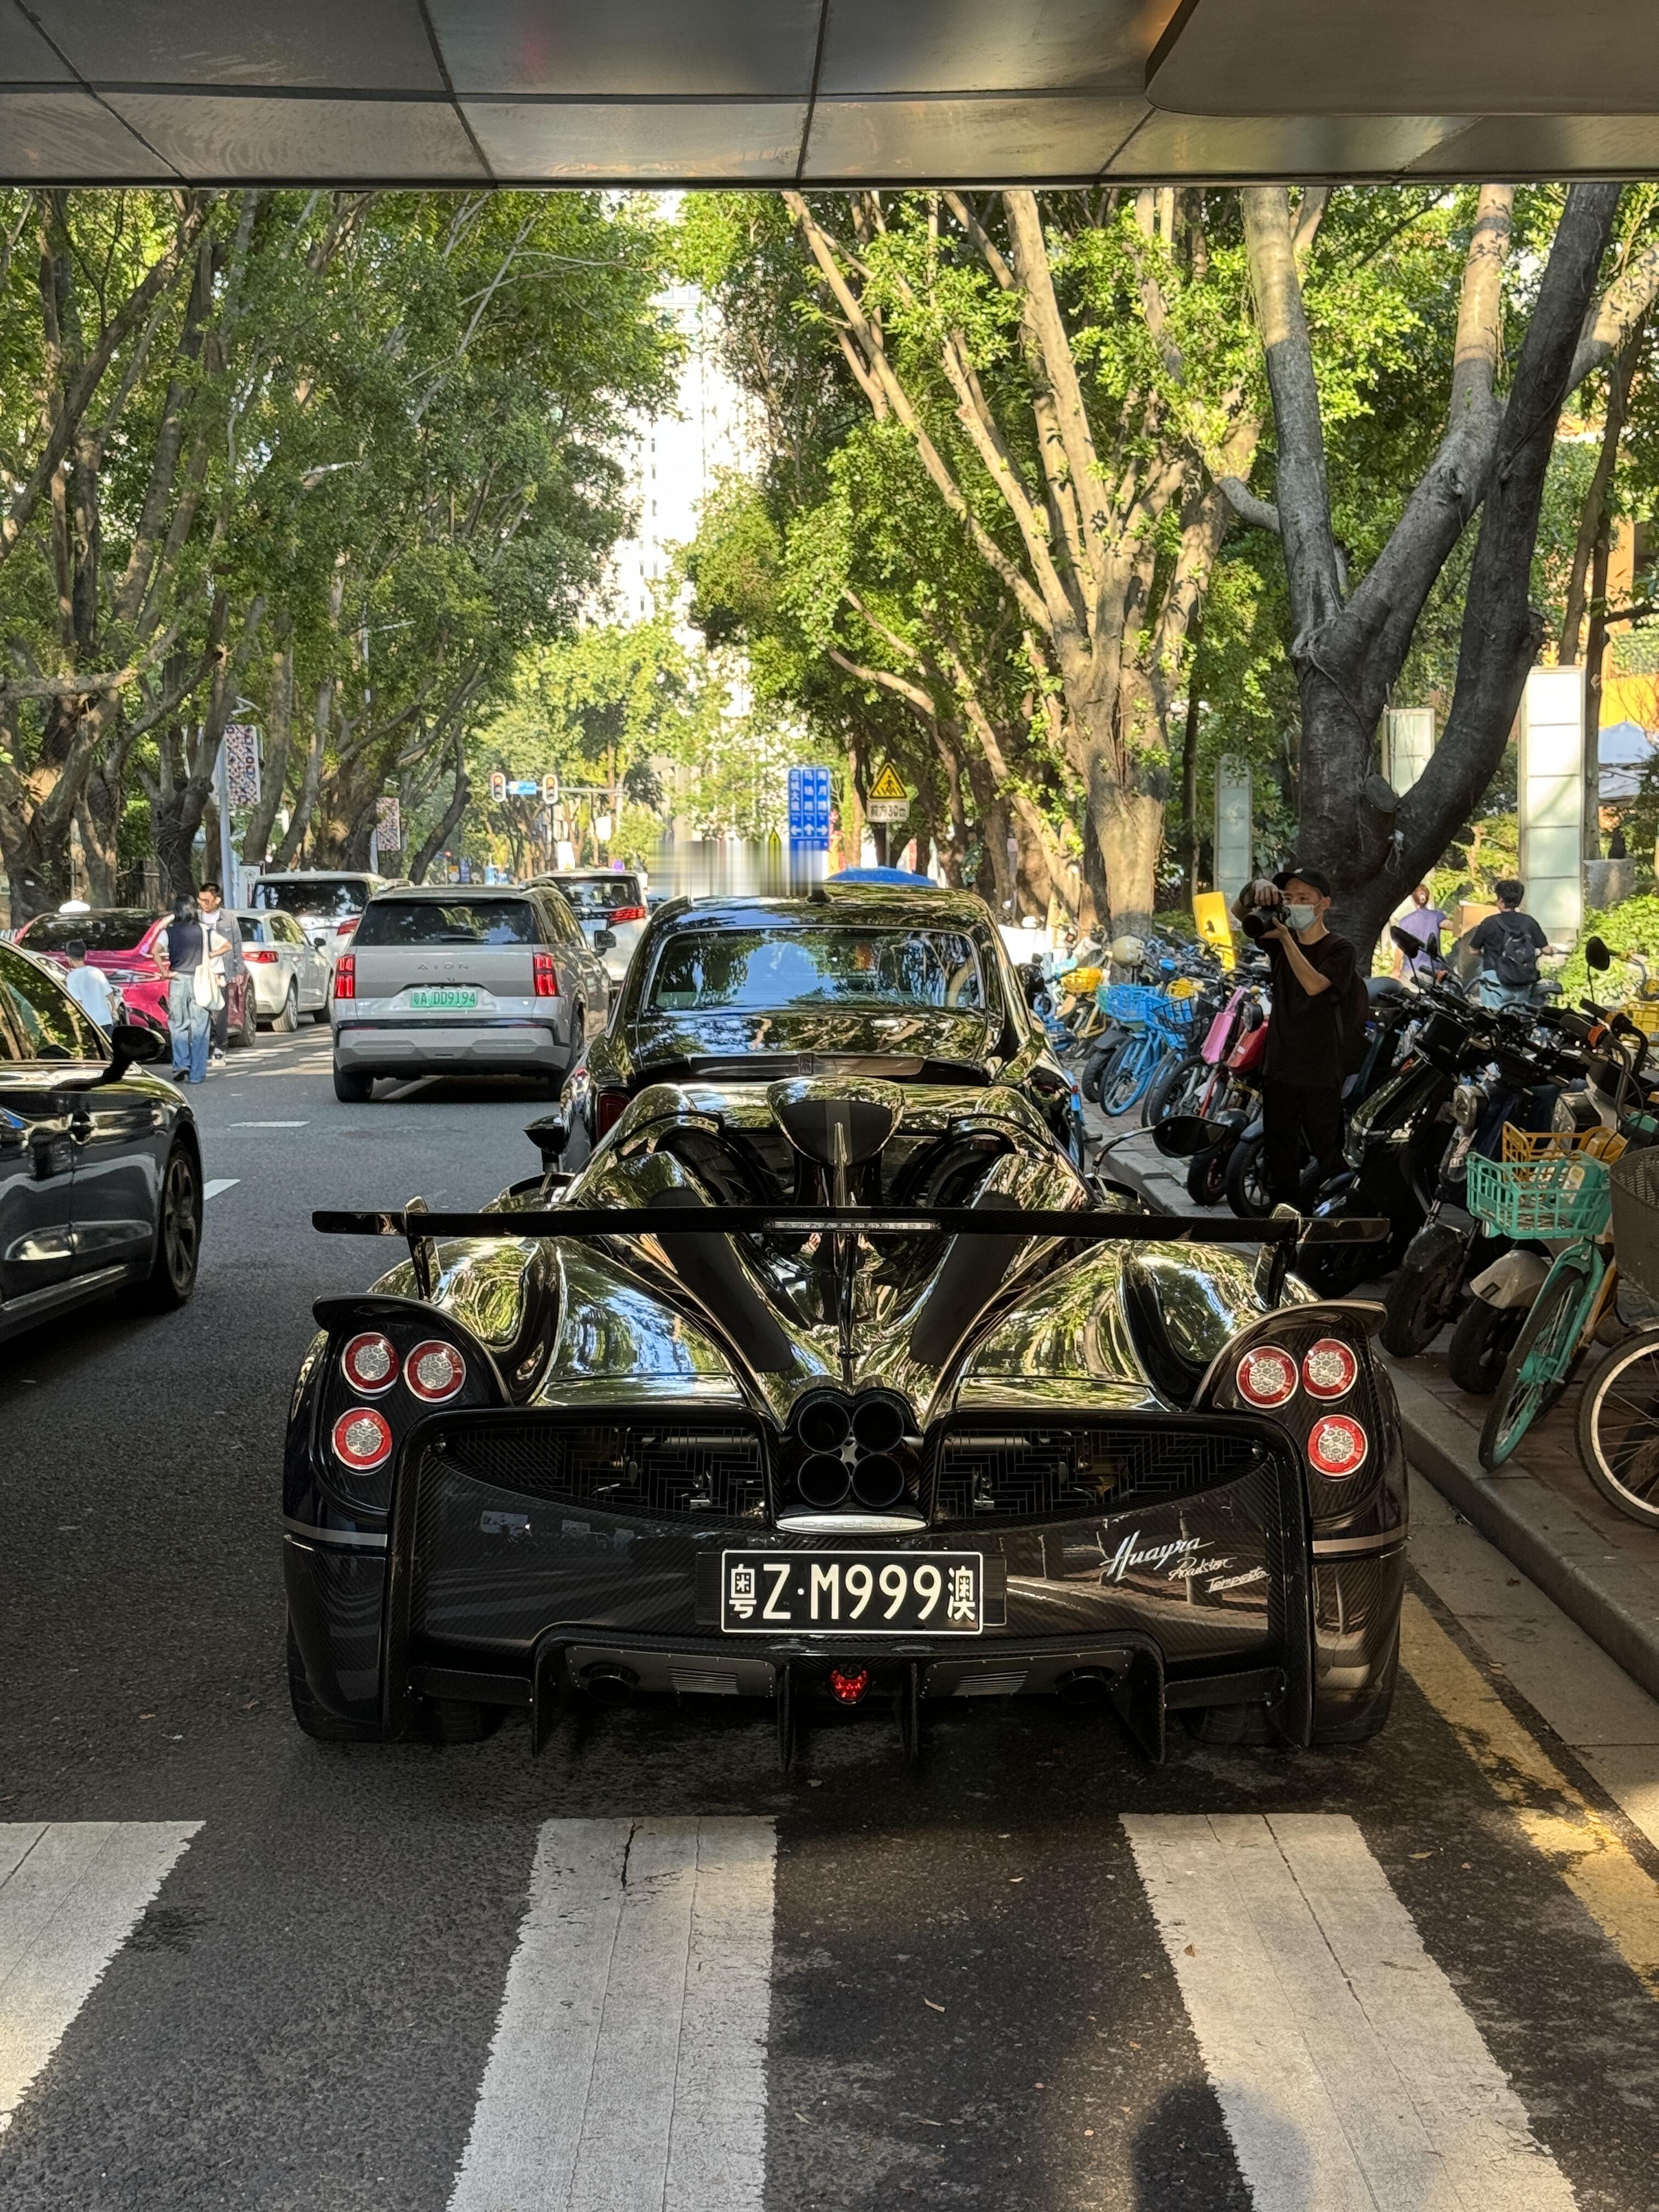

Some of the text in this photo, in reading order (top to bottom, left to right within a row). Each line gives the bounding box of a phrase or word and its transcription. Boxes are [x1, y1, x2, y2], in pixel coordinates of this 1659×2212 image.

[417, 961, 470, 970] AION
[1098, 1529, 1215, 1583] Huayra
[1168, 1556, 1238, 1581] Roadster
[1204, 1566, 1271, 1594] Tempesta
